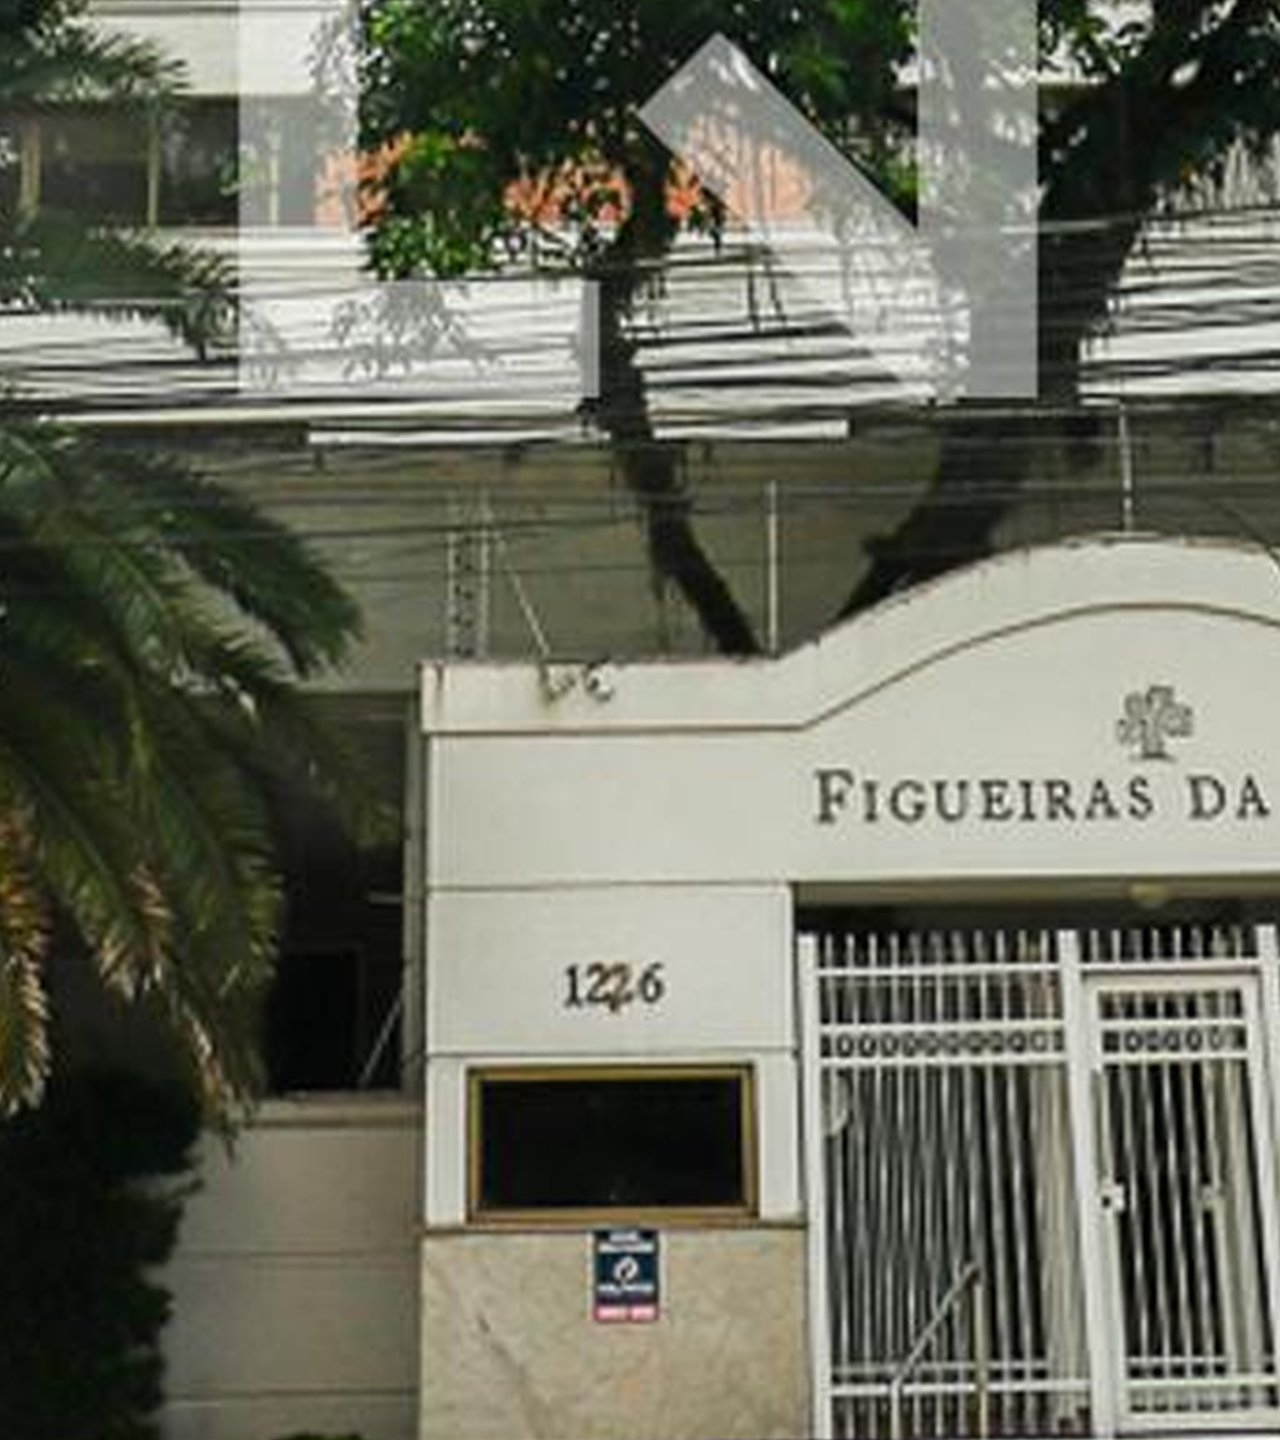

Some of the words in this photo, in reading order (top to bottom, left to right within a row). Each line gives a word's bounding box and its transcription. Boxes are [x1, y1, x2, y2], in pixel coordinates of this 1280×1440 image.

[815, 768, 1154, 822] FIGUEIRAS
[1186, 774, 1271, 820] DA
[563, 961, 666, 1013] 1226
